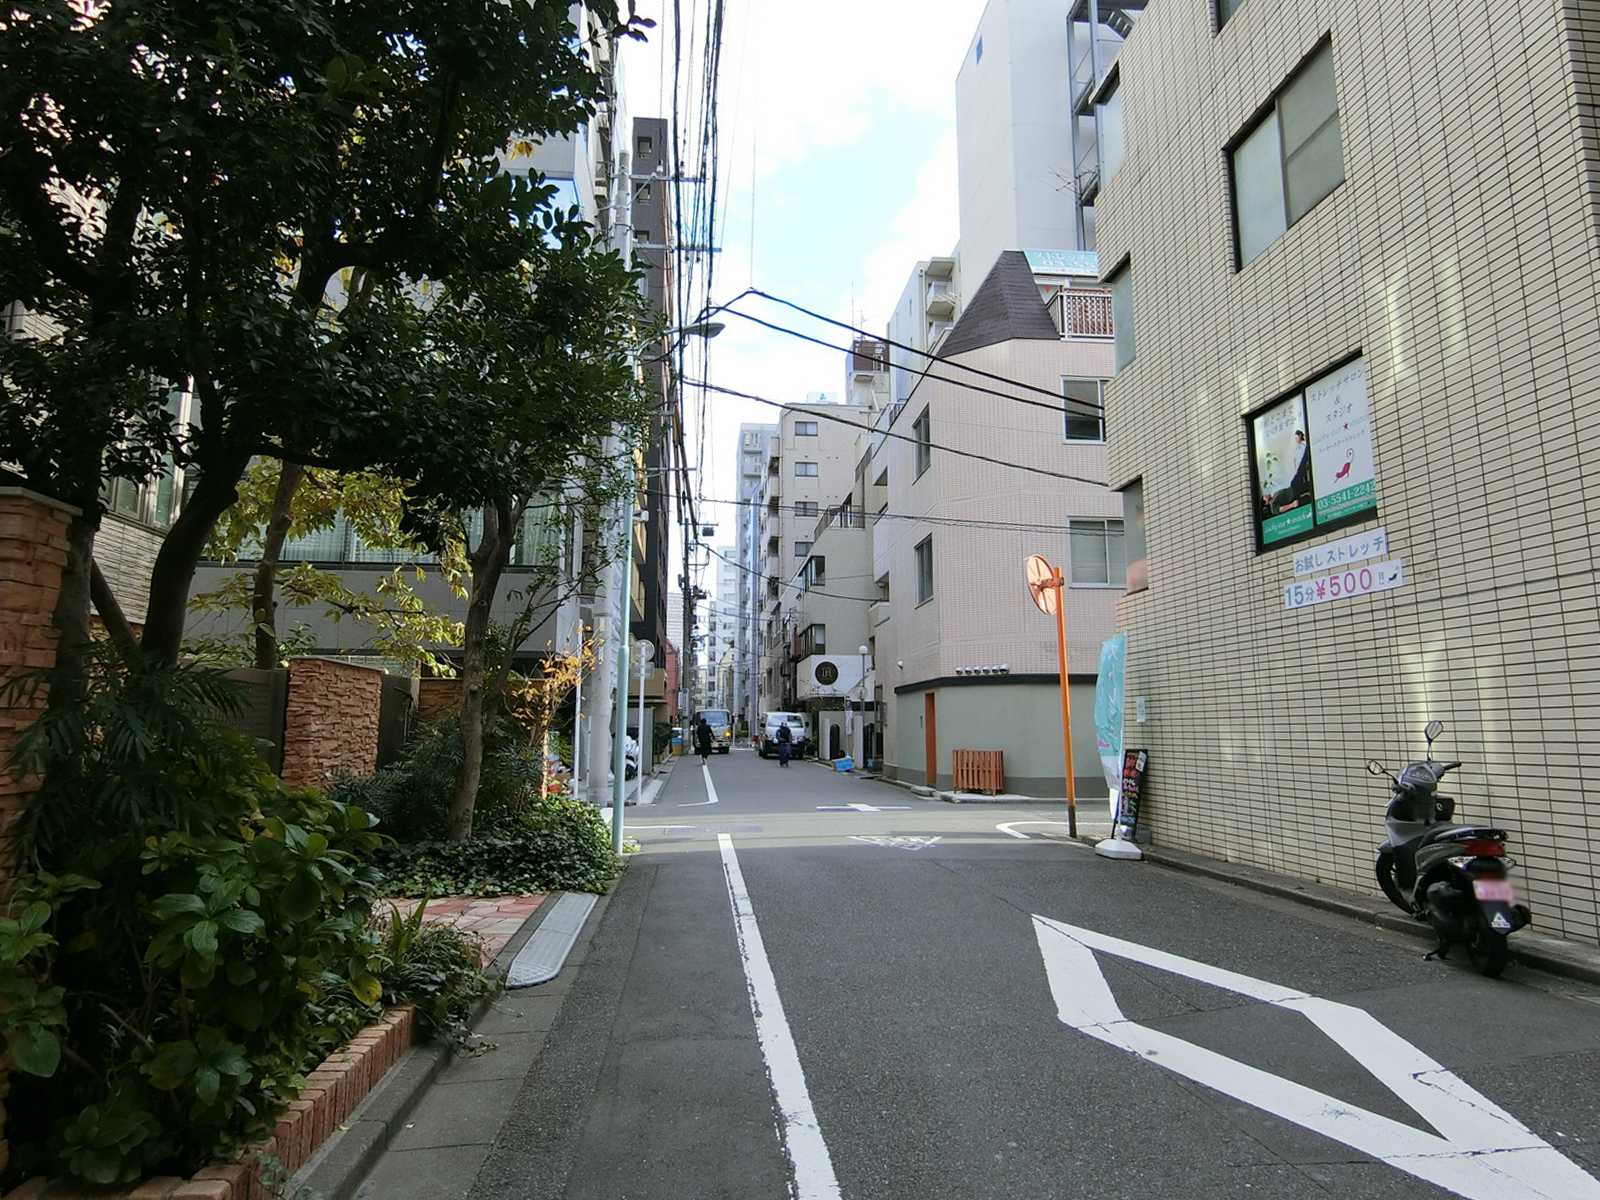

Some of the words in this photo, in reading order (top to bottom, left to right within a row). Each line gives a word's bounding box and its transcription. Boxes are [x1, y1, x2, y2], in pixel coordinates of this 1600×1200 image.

[1310, 369, 1364, 404] ストレッチサロン
[1325, 402, 1353, 424] スタジオ
